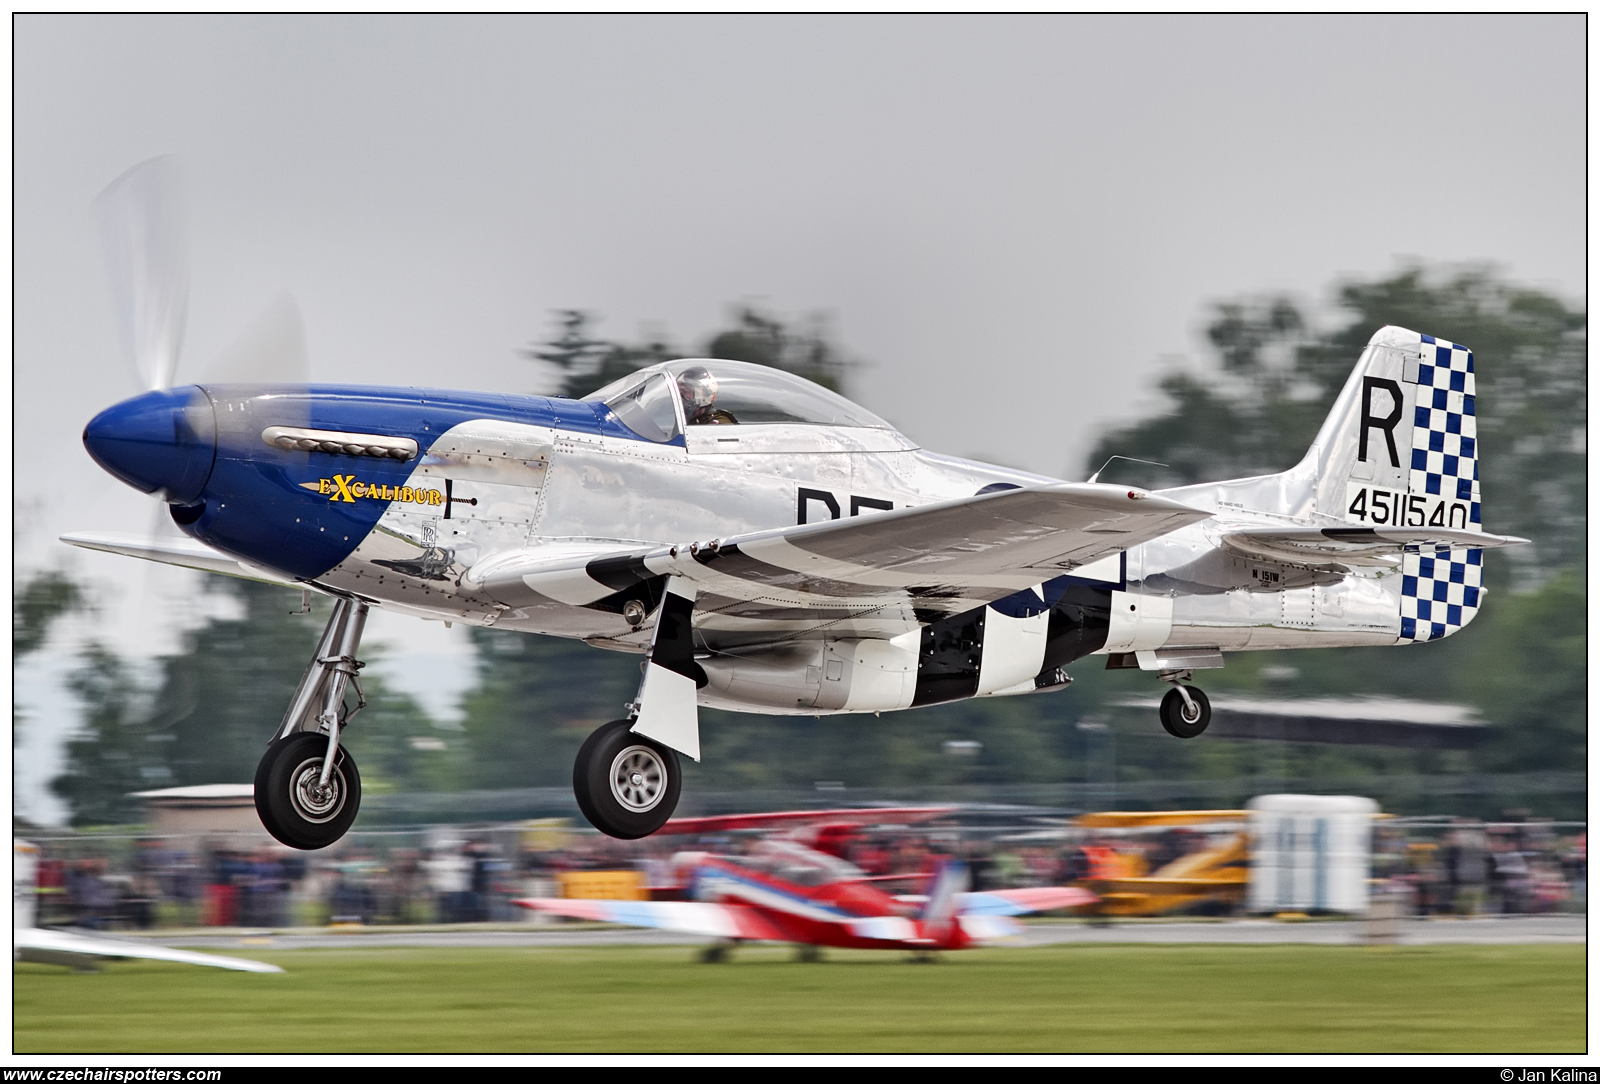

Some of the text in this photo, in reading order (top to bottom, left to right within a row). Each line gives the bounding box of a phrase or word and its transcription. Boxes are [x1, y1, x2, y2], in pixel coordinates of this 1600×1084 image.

[1358, 376, 1404, 468] R
[317, 474, 442, 506] EXCALIBUR
[1349, 488, 1467, 529] 4511540
